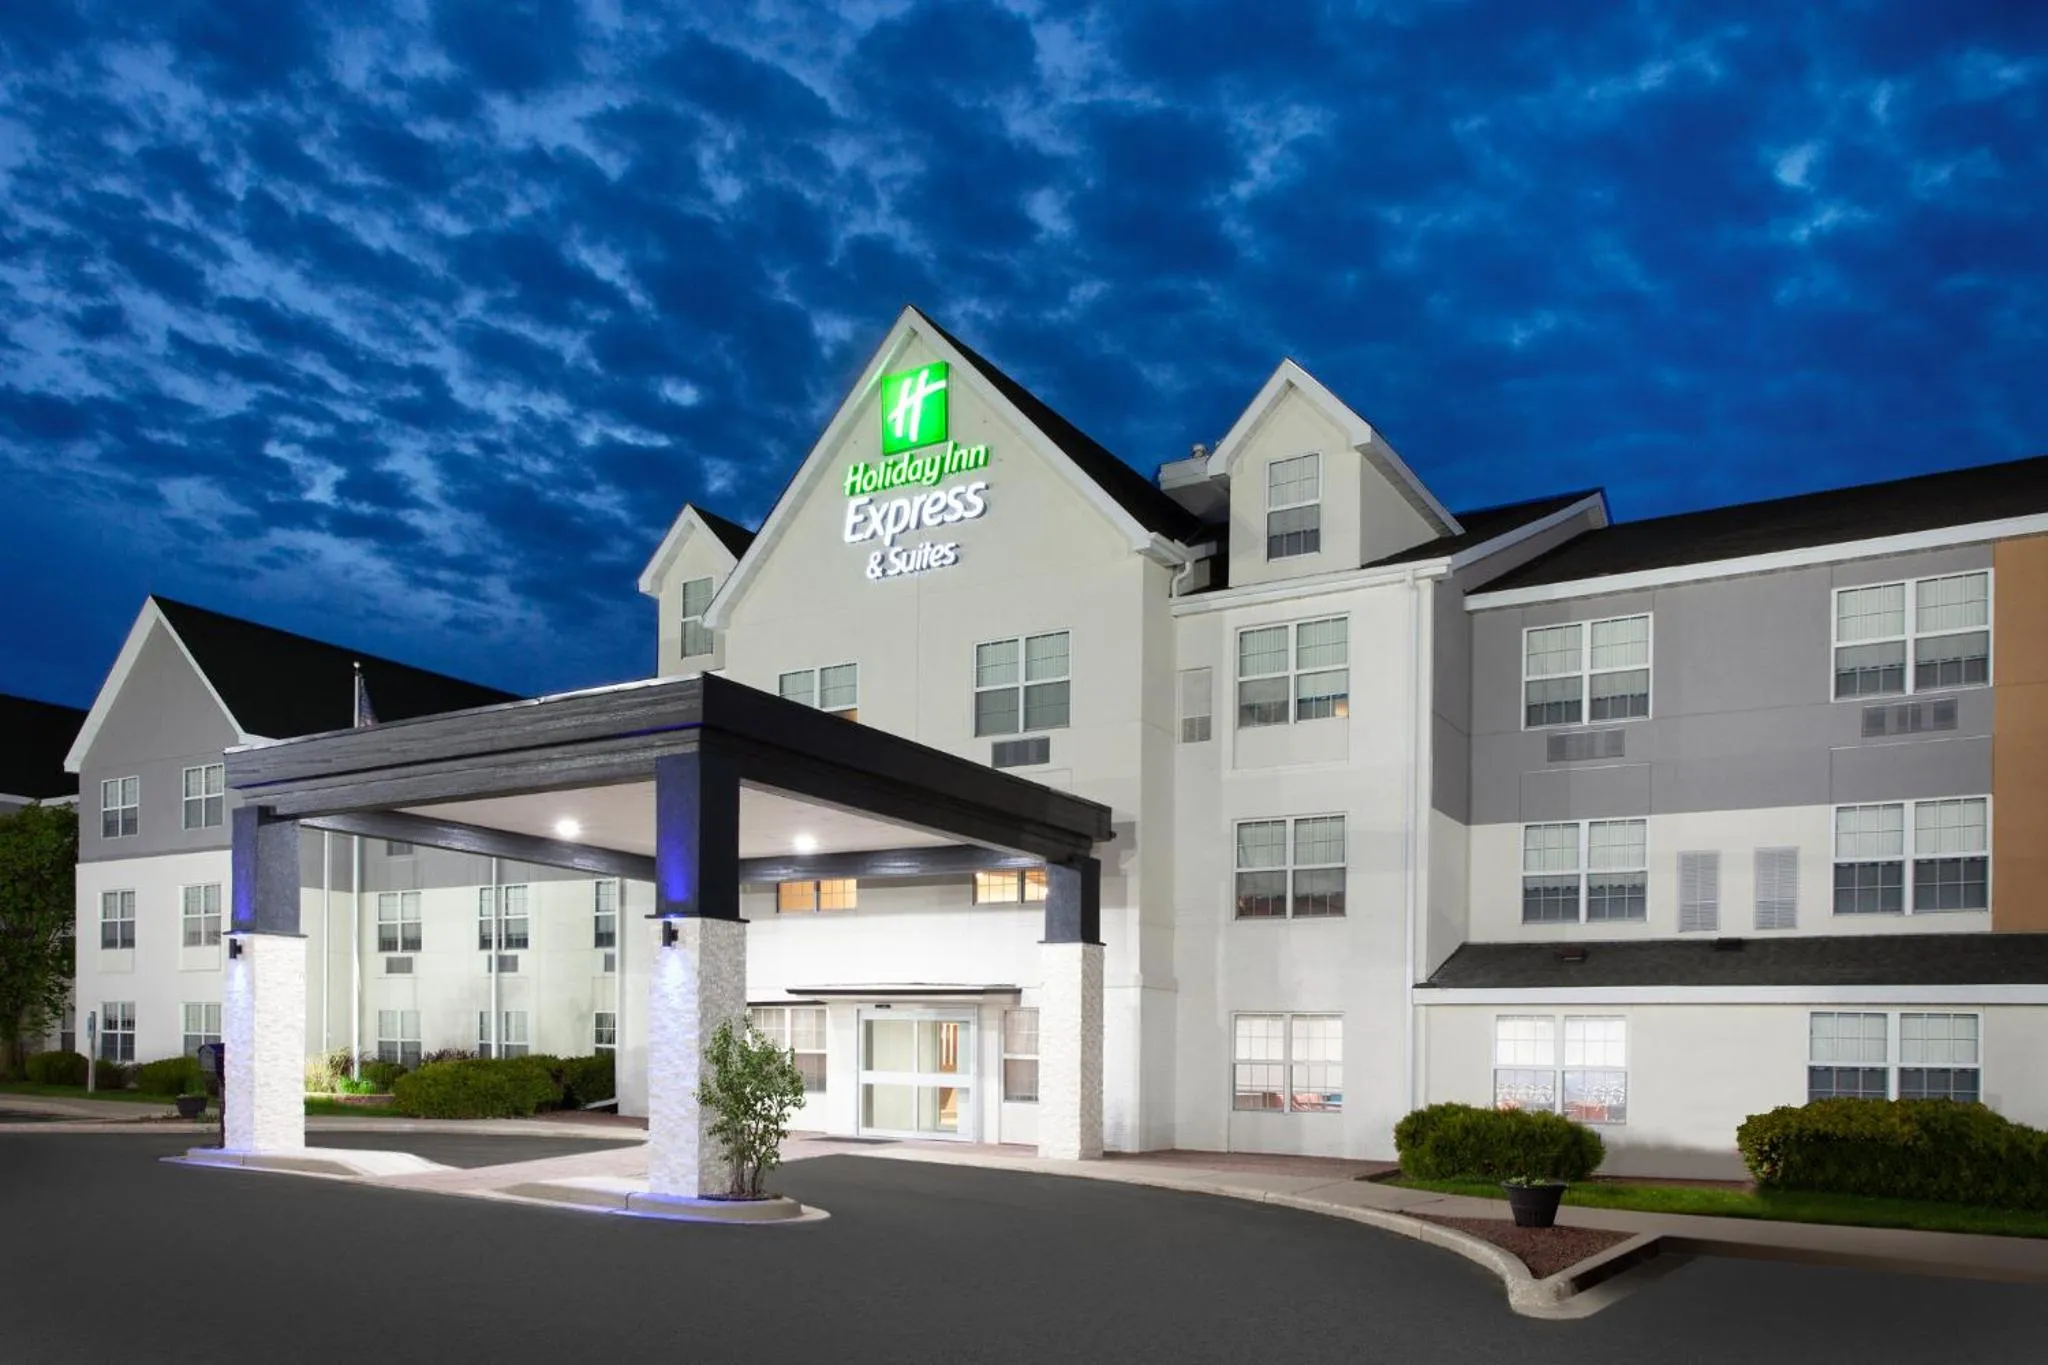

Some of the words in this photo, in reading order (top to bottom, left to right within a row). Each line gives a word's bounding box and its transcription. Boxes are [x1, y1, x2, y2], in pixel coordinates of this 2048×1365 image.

[844, 453, 943, 496] Holiday
[943, 440, 989, 474] Inn
[844, 481, 988, 546] Express
[866, 550, 884, 579] &
[887, 542, 959, 575] Suites
